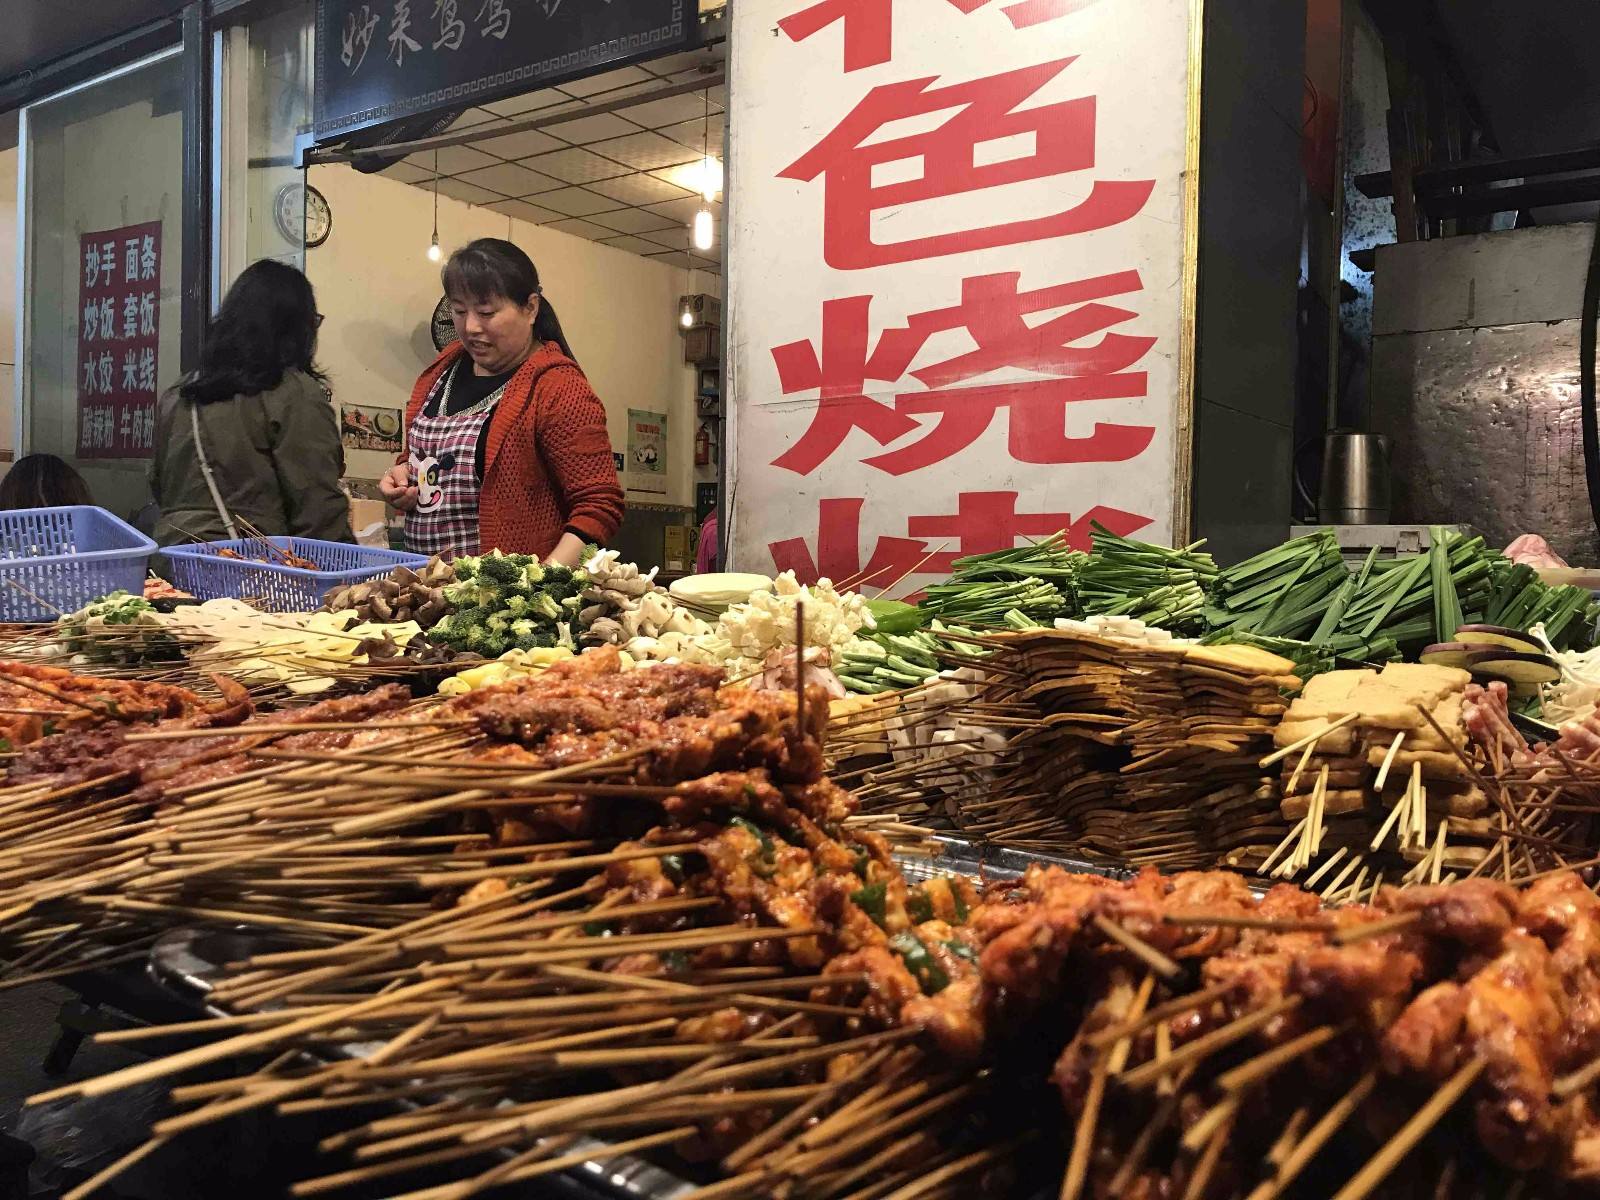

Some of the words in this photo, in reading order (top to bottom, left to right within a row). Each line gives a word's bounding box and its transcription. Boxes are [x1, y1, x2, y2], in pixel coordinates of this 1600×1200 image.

[85, 240, 116, 288] 抄手
[124, 234, 157, 283] 面条
[83, 297, 115, 341] 炒饭
[123, 291, 156, 338] 套饭
[84, 351, 114, 396] 水饺
[122, 347, 155, 393] 米线
[120, 403, 155, 449] 牛肉粉
